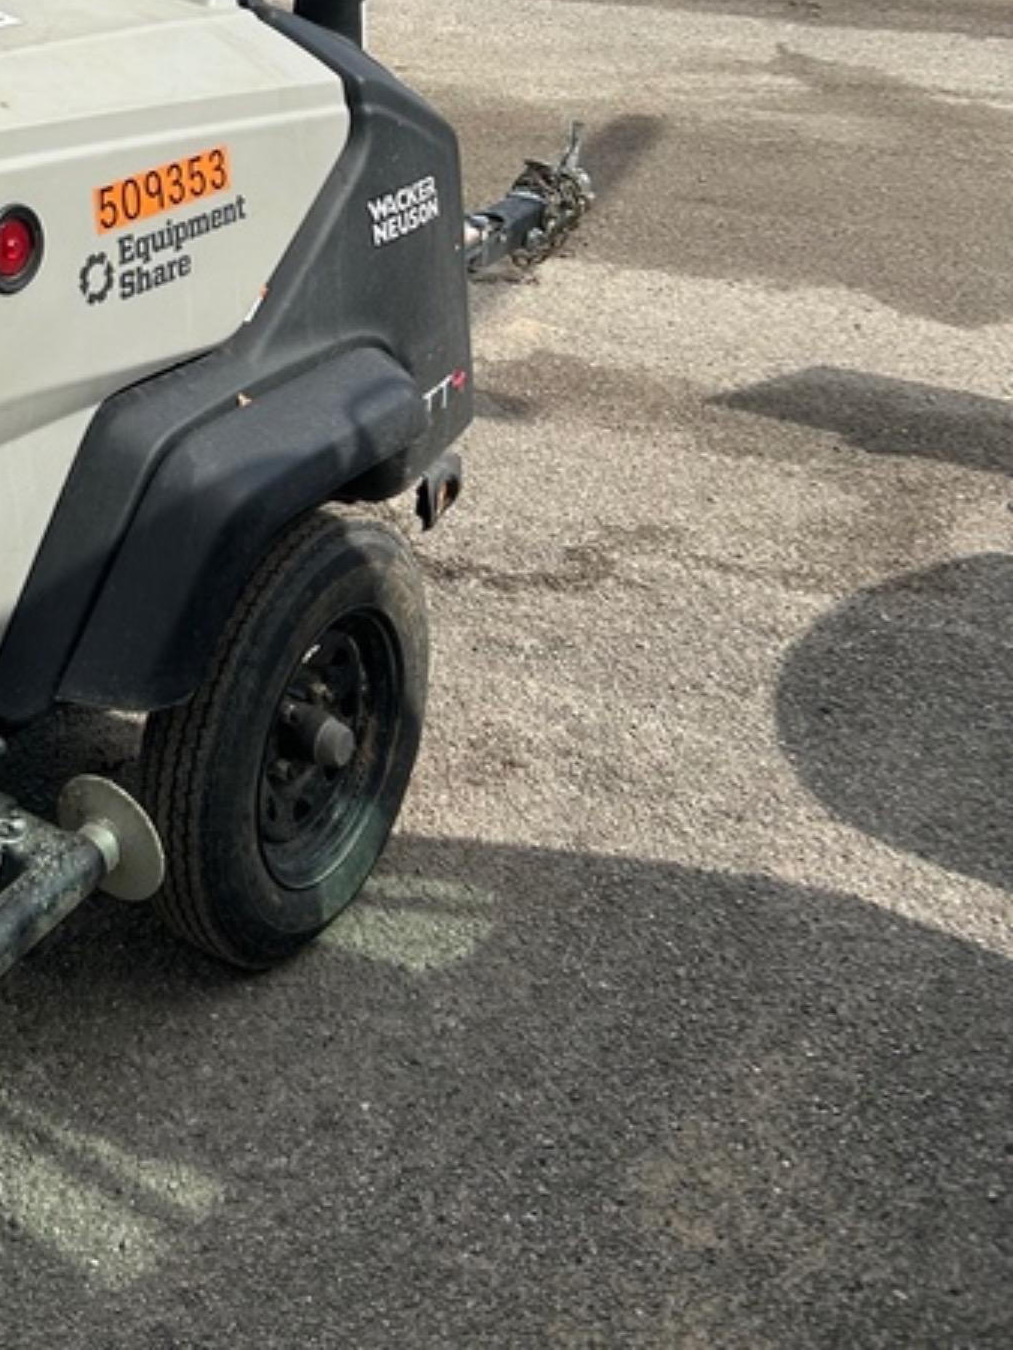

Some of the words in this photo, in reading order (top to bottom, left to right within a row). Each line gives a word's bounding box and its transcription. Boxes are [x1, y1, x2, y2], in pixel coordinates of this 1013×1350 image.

[99, 149, 228, 229] 509353
[367, 176, 435, 221] WACKER
[118, 194, 246, 265] Equipment
[373, 196, 439, 246] NEUSON
[119, 254, 192, 299] Share
